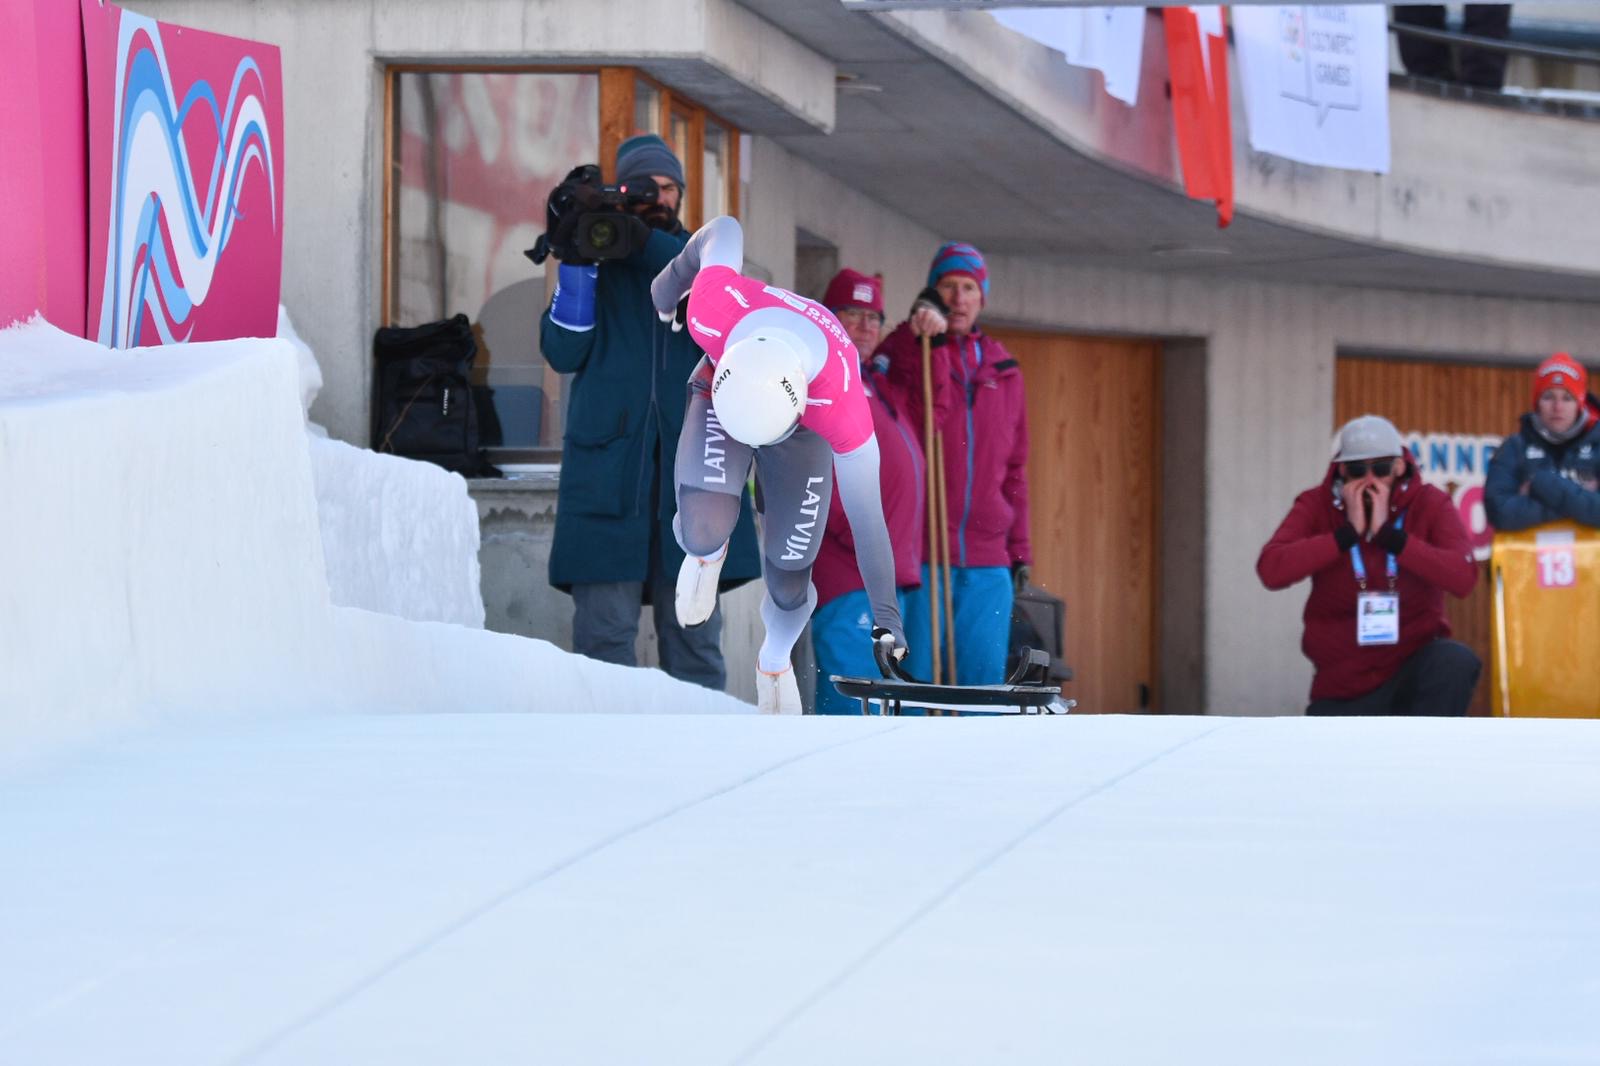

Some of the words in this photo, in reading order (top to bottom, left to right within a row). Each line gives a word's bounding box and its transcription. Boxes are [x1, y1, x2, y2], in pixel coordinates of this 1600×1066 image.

[780, 376, 799, 407] uvex
[780, 476, 824, 561] LATVIJA
[1539, 551, 1575, 586] 13
